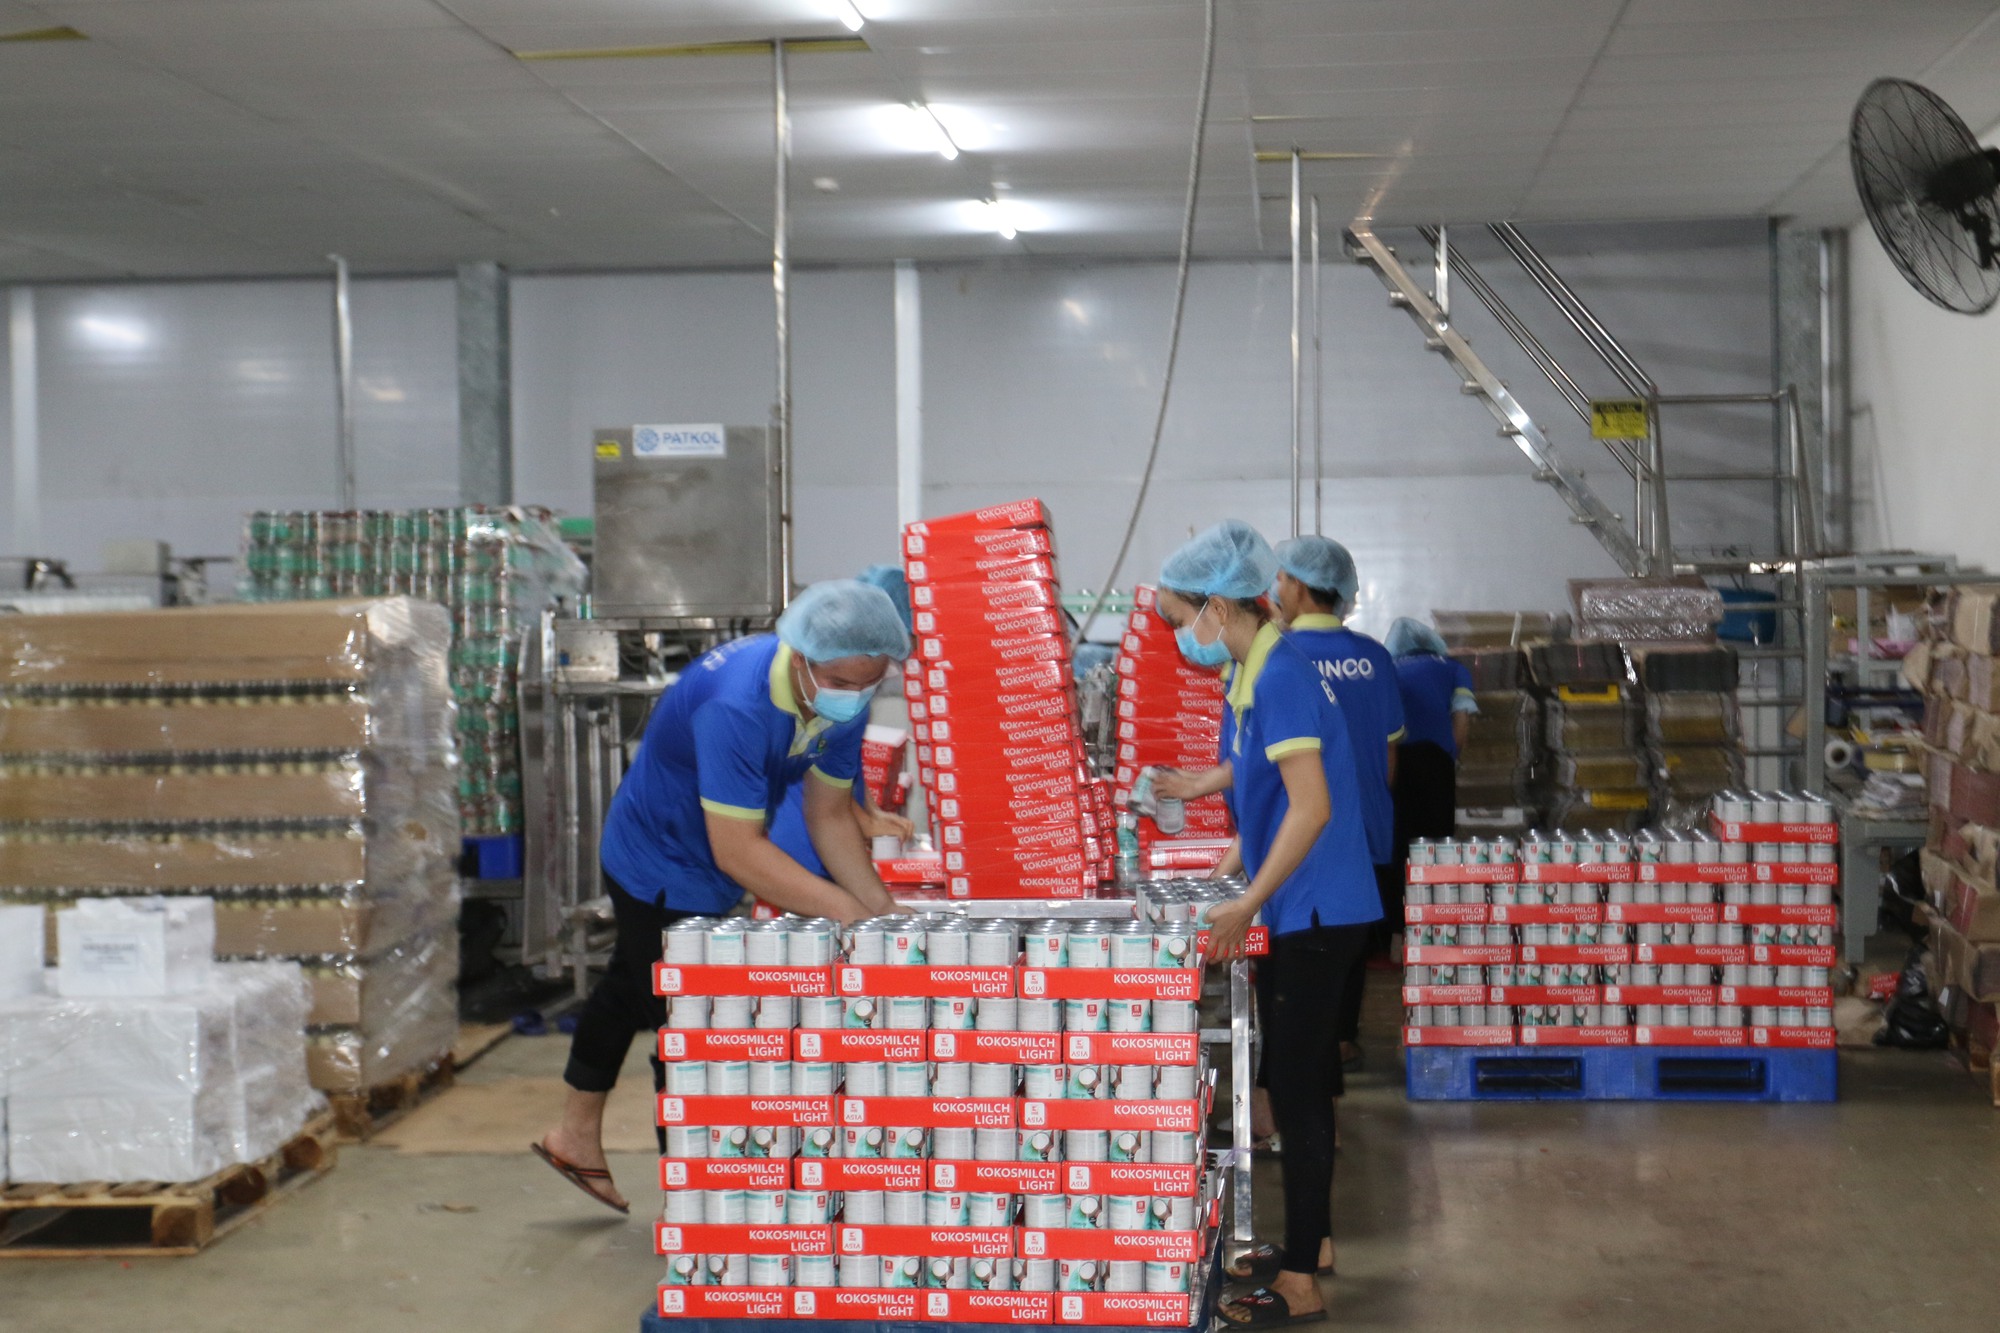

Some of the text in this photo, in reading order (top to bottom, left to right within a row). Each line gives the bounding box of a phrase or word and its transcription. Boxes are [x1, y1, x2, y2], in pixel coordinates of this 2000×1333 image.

[663, 432, 720, 444] PATKOL
[976, 501, 1034, 519] KOKOSMILCH
[1009, 510, 1035, 521] LIGHT
[1001, 641, 1060, 658] KOKOSMILCH
[1312, 657, 1372, 677] INCO
[1005, 697, 1063, 714] KOKOSMILCH
[1038, 705, 1065, 717] LIGHT
[1008, 724, 1066, 741] KOKOSMILCH
[1041, 732, 1068, 743] LIGHT
[1011, 749, 1069, 767] KOKOSMILCH
[1044, 759, 1070, 770] LIGHT
[1013, 776, 1071, 793] KOKOSMILCH
[1046, 785, 1073, 796] LIGHT
[1015, 801, 1074, 818] KOKOSMILCH
[1048, 810, 1075, 821] LIGHT
[1017, 827, 1076, 845] KOKOSMILCH
[1051, 836, 1078, 847] LIGHT
[892, 862, 941, 871] KOKOSMILC
[1023, 853, 1081, 871] KOKOSMILCH
[1056, 862, 1082, 873] LIGHT
[1020, 877, 1078, 886] KOKOSMILCH
[1051, 886, 1078, 894] LIGHT
[748, 971, 825, 982] KOKOSMILCH
[930, 971, 1008, 981] KOKOSMILCH
[1114, 974, 1191, 984] KOKOSMILCH
[790, 983, 825, 993] LIGHT
[972, 983, 1007, 993] LIGHT
[1156, 986, 1191, 996] LIGHT
[706, 1034, 783, 1045] KOKOSMILCH
[842, 1035, 919, 1045] KOKOSMILCH
[977, 1037, 1054, 1047] KOKOSMILCH
[1113, 1038, 1190, 1049] KOKOSMILCH
[748, 1046, 783, 1056] LIGHT
[884, 1047, 919, 1057] LIGHT
[1019, 1049, 1054, 1059] LIGHT
[1155, 1050, 1190, 1060] LIGHT
[751, 1100, 828, 1111] KOKOSMILCH
[933, 1103, 1010, 1113] KOKOSMILCH
[1114, 1105, 1191, 1115] KOKOSMILCH
[793, 1112, 828, 1122] LIGHT
[975, 1115, 1010, 1125] LIGHT
[1156, 1117, 1191, 1127] LIGHT
[707, 1163, 784, 1174] KOKOSMILCH
[843, 1164, 920, 1175] KOKOSMILCH
[977, 1168, 1054, 1178] KOKOSMILCH
[1112, 1169, 1189, 1180] KOKOSMILCH
[749, 1175, 784, 1185] LIGHT
[885, 1176, 920, 1186] LIGHT
[1019, 1180, 1054, 1190] LIGHT
[1154, 1181, 1189, 1191] LIGHT
[749, 1230, 826, 1240] KOKOSMILCH
[931, 1232, 1008, 1242] KOKOSMILCH
[1114, 1236, 1191, 1246] KOKOSMILCH
[791, 1242, 826, 1252] LIGHT
[973, 1244, 1008, 1254] LIGHT
[1156, 1248, 1191, 1258] LIGHT
[705, 1292, 782, 1302] KOKOSMILCH
[836, 1294, 914, 1304] KOKOSMILCH
[970, 1296, 1047, 1307] KOKOSMILCH
[747, 1304, 782, 1314] LIGHT
[1105, 1299, 1182, 1309] KOKOSMILCH
[878, 1306, 913, 1316] LIGHT
[1012, 1308, 1047, 1318] LIGHT
[1147, 1311, 1181, 1321] LIGHT
